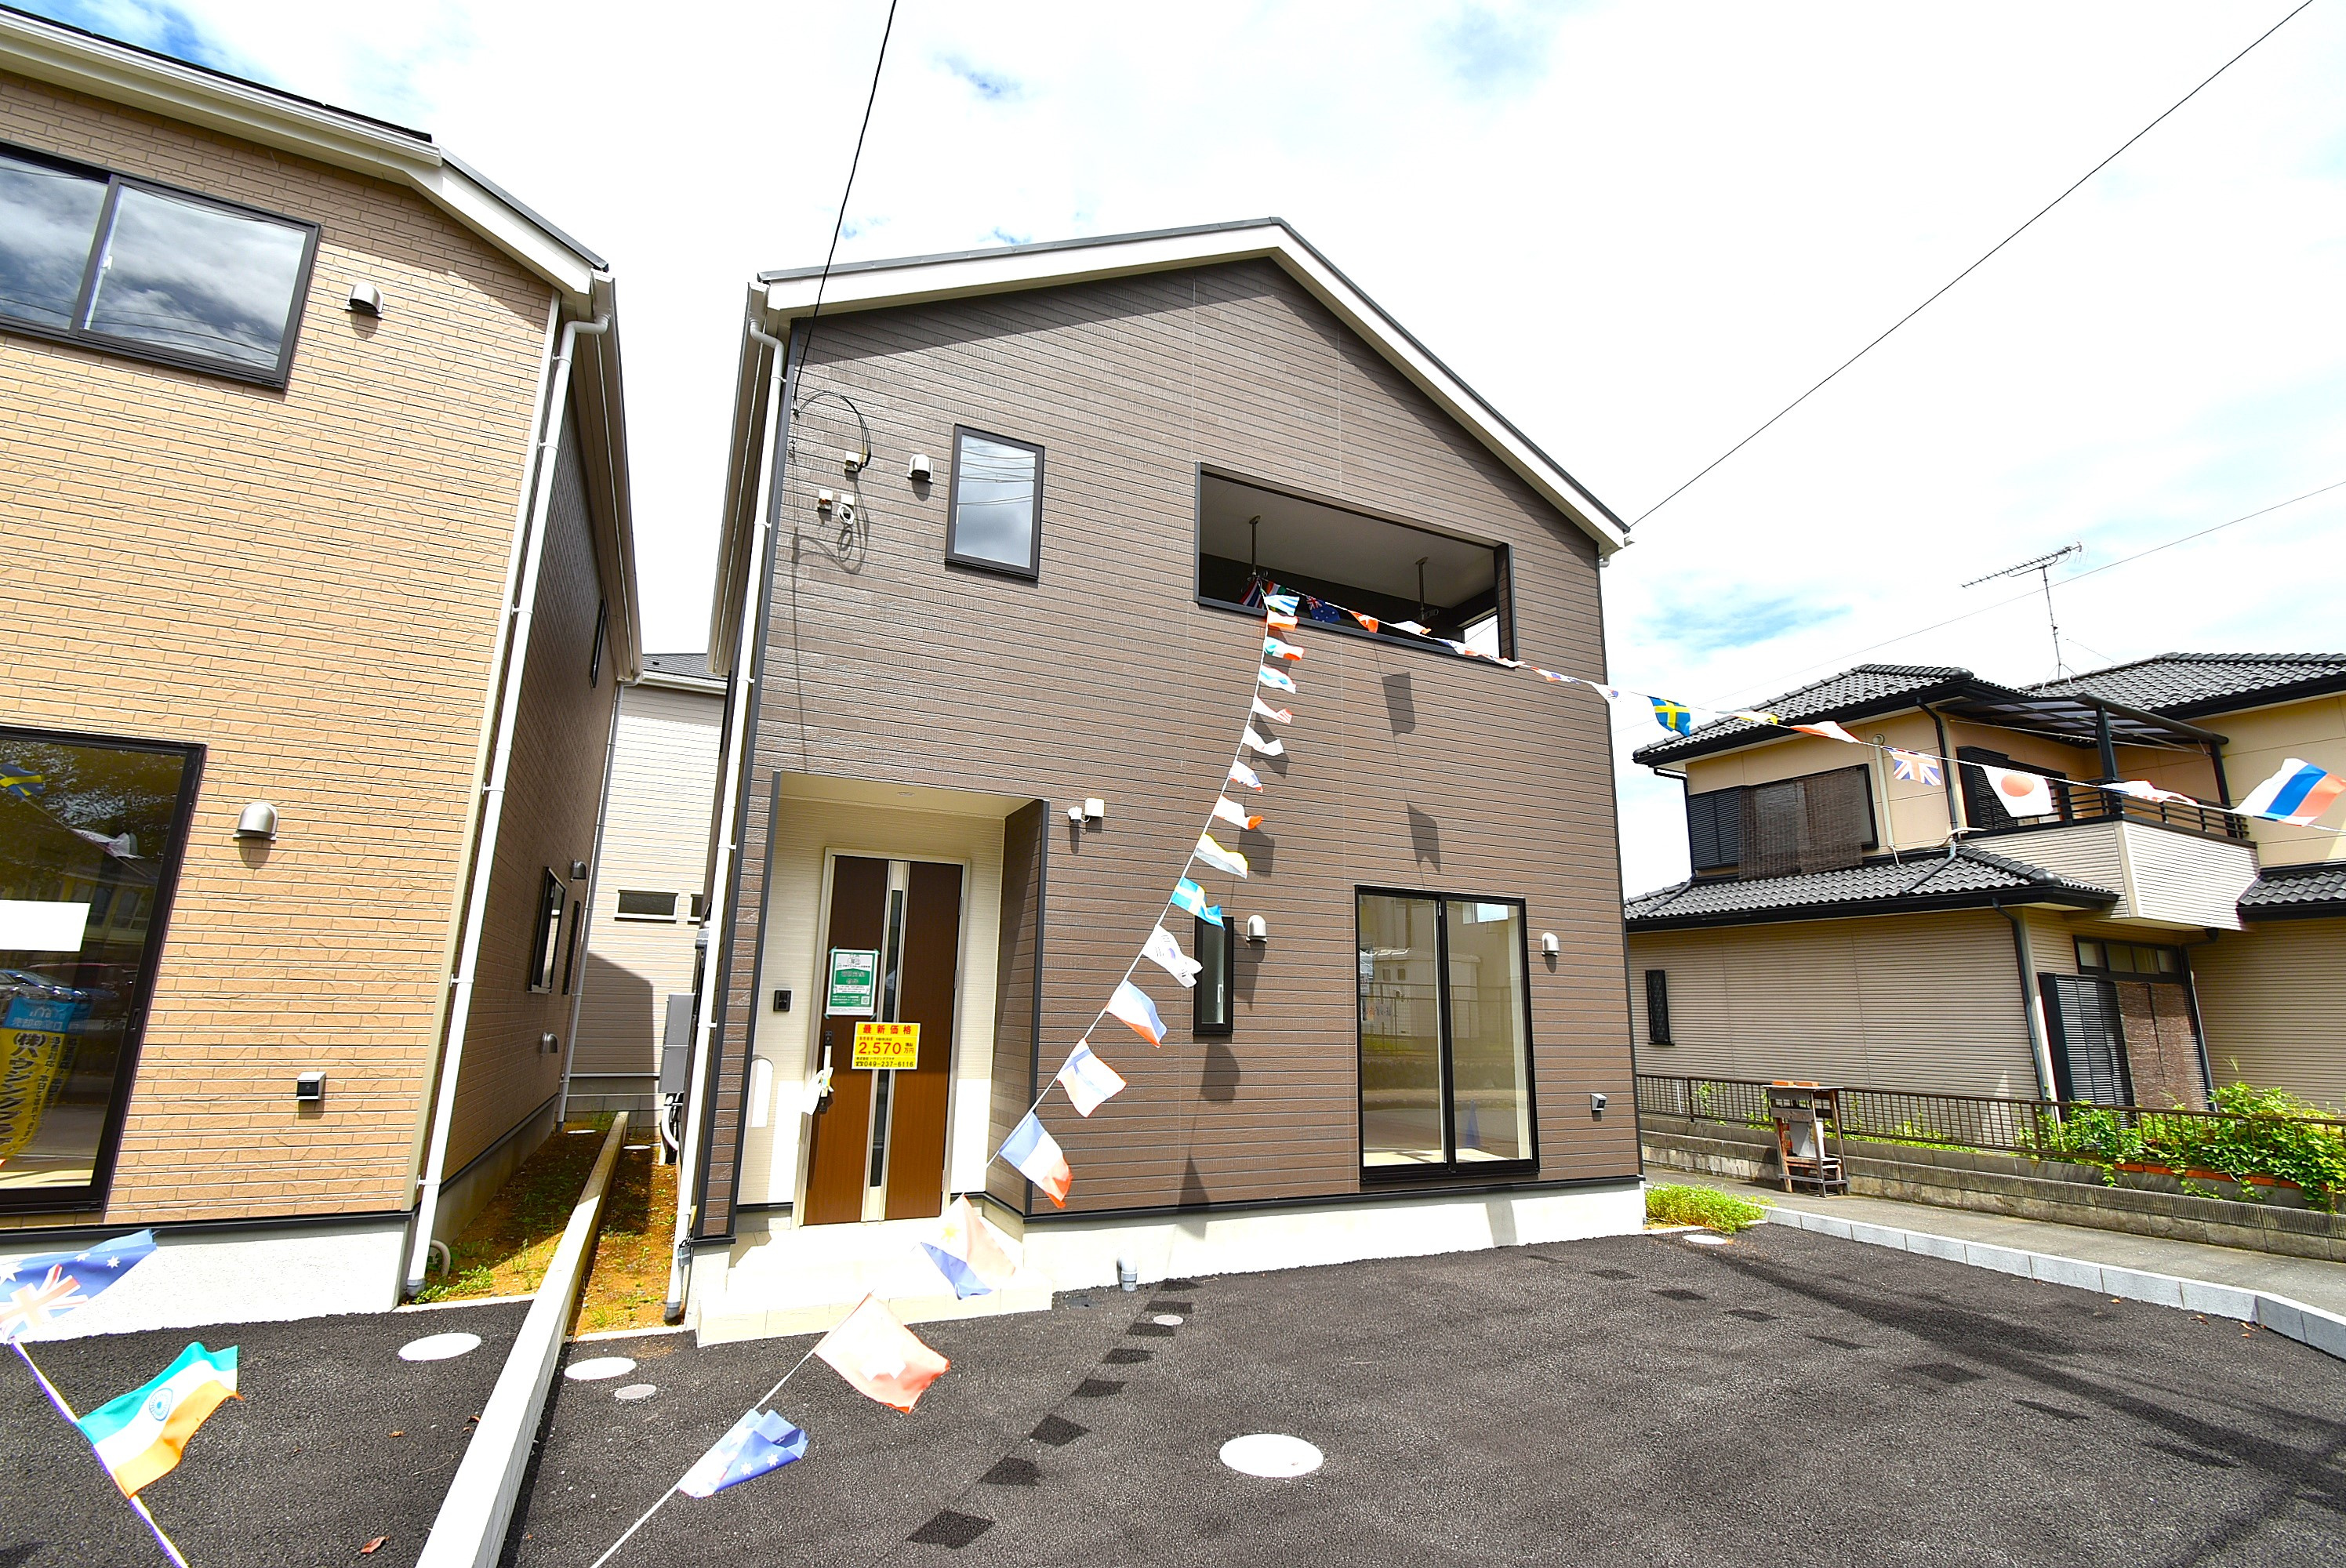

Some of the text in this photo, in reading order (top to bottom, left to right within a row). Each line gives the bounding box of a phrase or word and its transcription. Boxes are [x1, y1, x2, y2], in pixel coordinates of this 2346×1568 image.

[863, 1025, 911, 1034] 最新価格
[859, 1042, 901, 1054] 2,570
